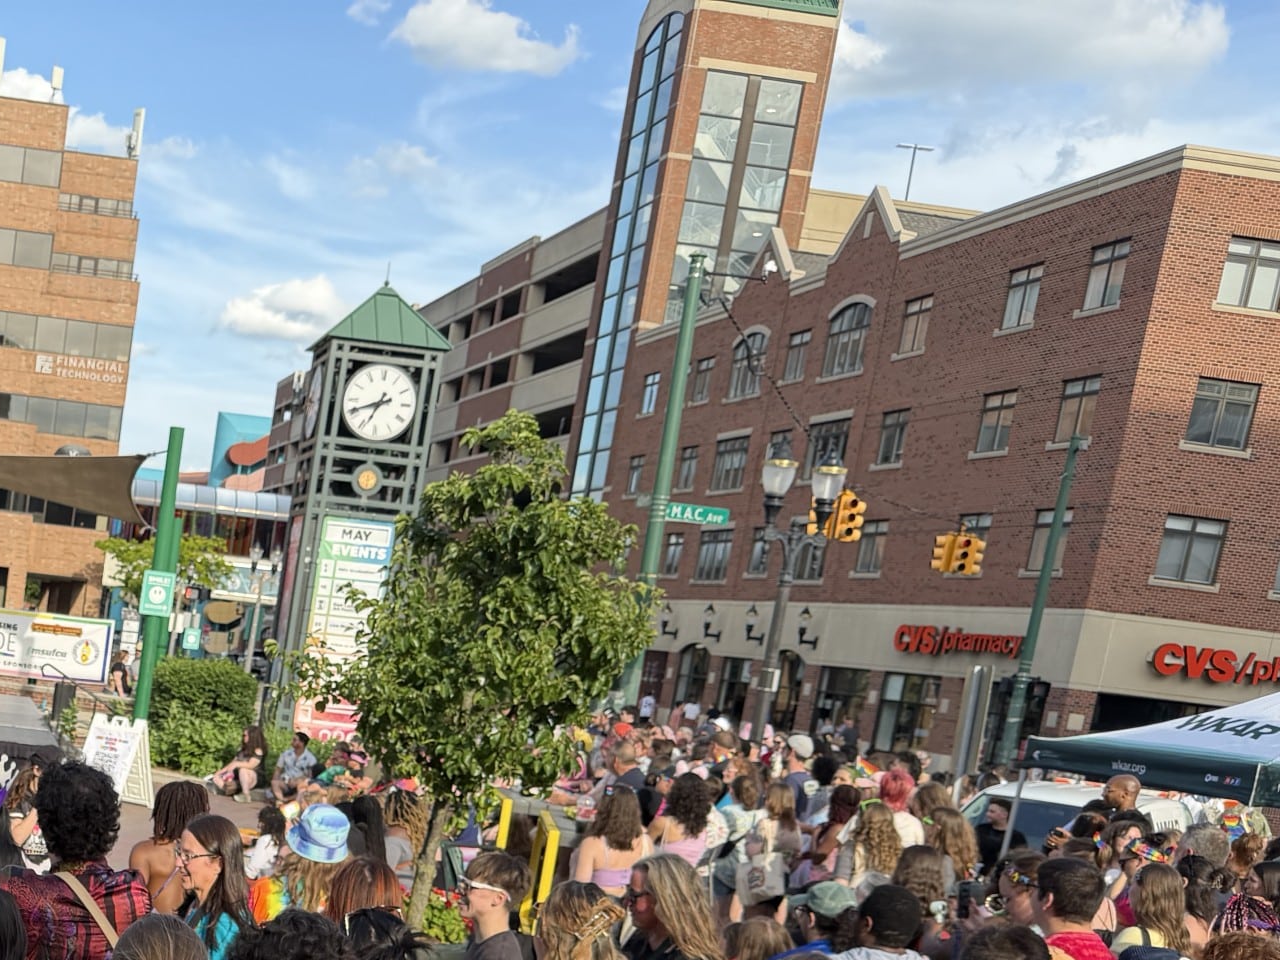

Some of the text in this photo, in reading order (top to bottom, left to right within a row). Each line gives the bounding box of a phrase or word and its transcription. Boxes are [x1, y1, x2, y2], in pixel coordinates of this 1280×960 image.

[56, 355, 125, 373] FINANCIAL
[56, 368, 124, 384] TECHNOLOGY
[706, 513, 723, 524] Ave
[341, 528, 372, 541] MAY
[331, 543, 388, 561] EVENTS
[1176, 715, 1280, 740] WKAR
[1111, 759, 1147, 775] wkar.org
